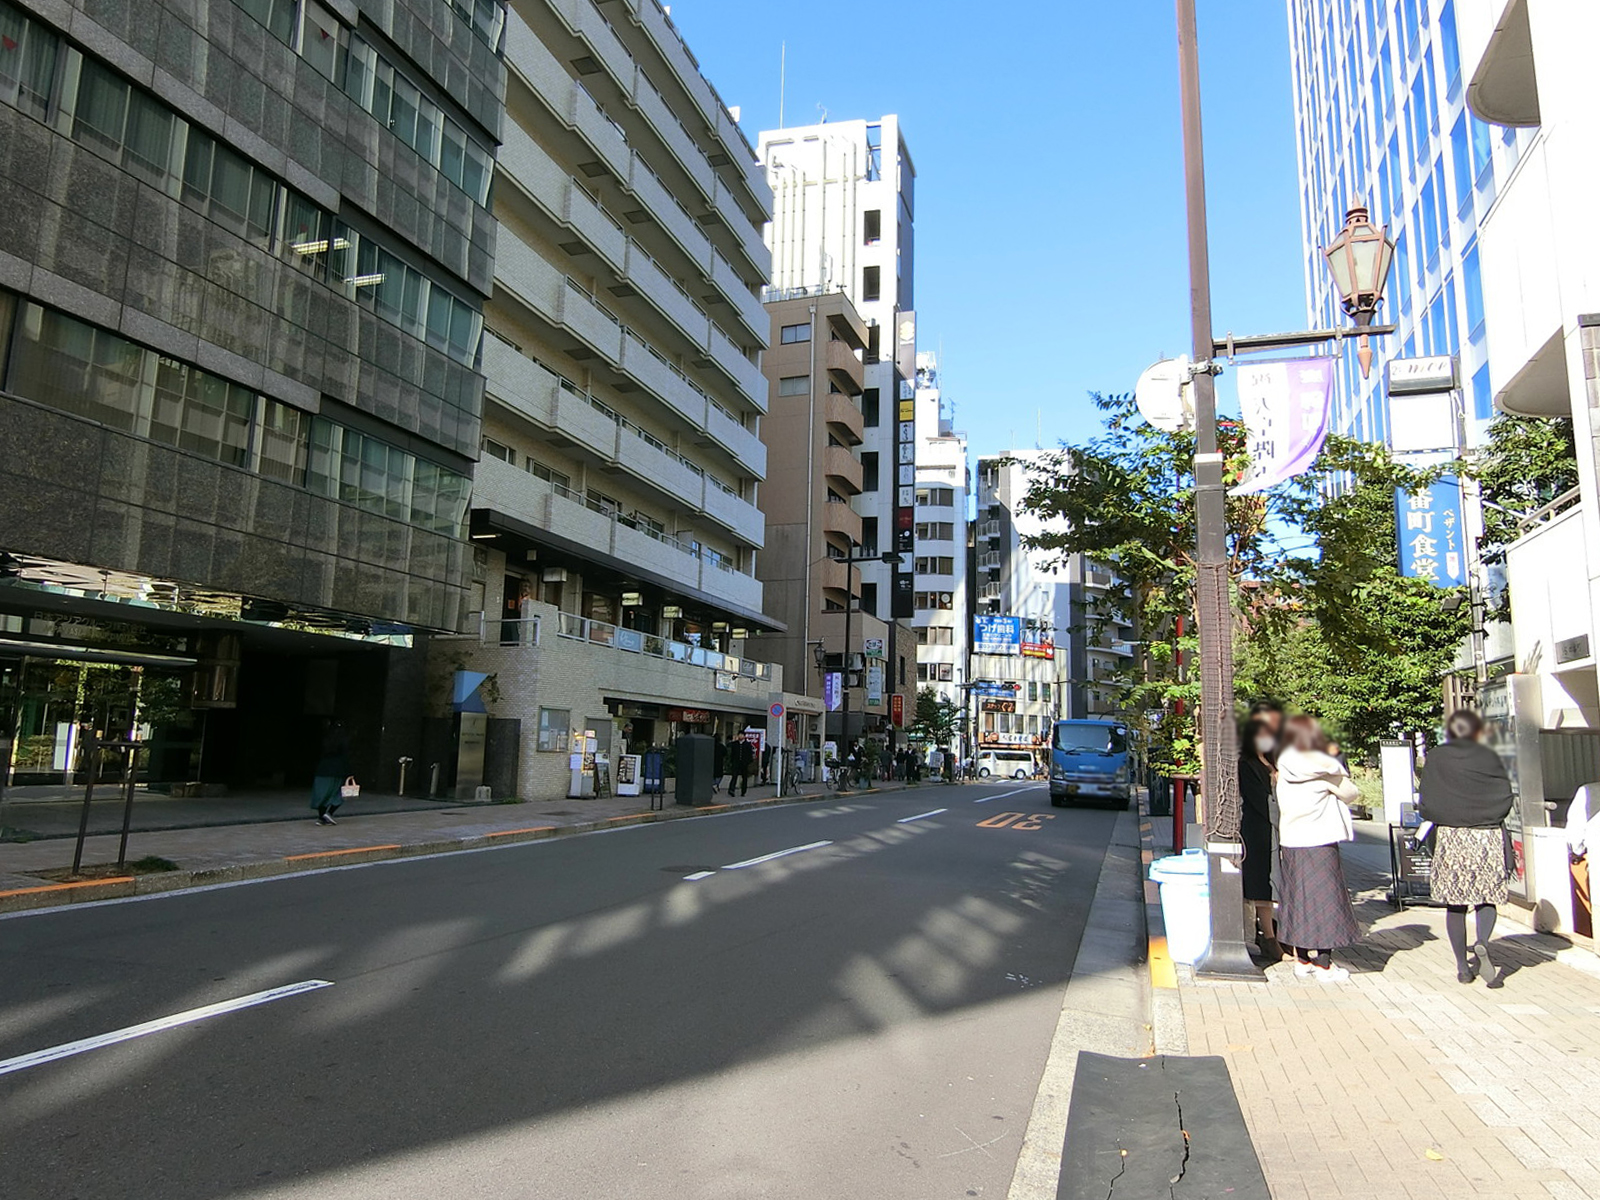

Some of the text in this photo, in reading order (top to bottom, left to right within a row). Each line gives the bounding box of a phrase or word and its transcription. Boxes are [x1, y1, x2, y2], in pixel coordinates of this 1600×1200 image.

[1407, 488, 1439, 580] 番町食堂
[976, 811, 1056, 830] 30
